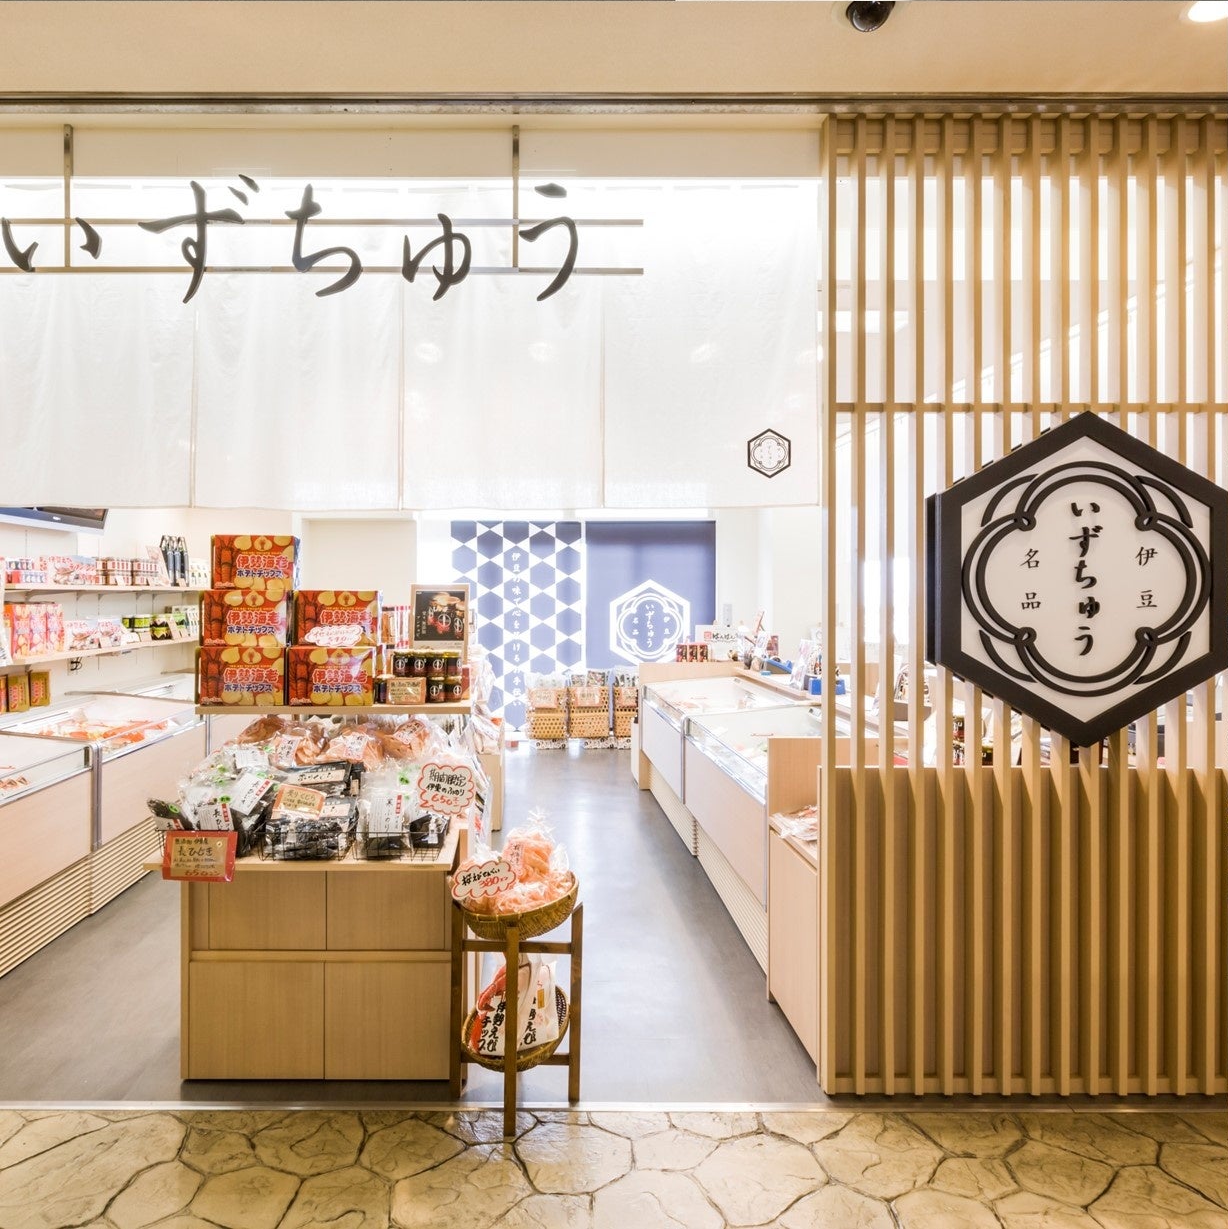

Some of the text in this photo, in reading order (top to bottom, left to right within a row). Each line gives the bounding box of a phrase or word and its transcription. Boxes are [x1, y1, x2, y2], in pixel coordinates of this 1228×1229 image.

[0, 174, 579, 305] いずちゅう
[236, 555, 289, 569] 伊勢海老
[1020, 548, 1042, 610] 名品
[1069, 501, 1104, 657] いずちゅう
[1135, 546, 1159, 609] 伊豆
[226, 610, 280, 625] 伊勢海老
[223, 668, 279, 683] 伊勢海老
